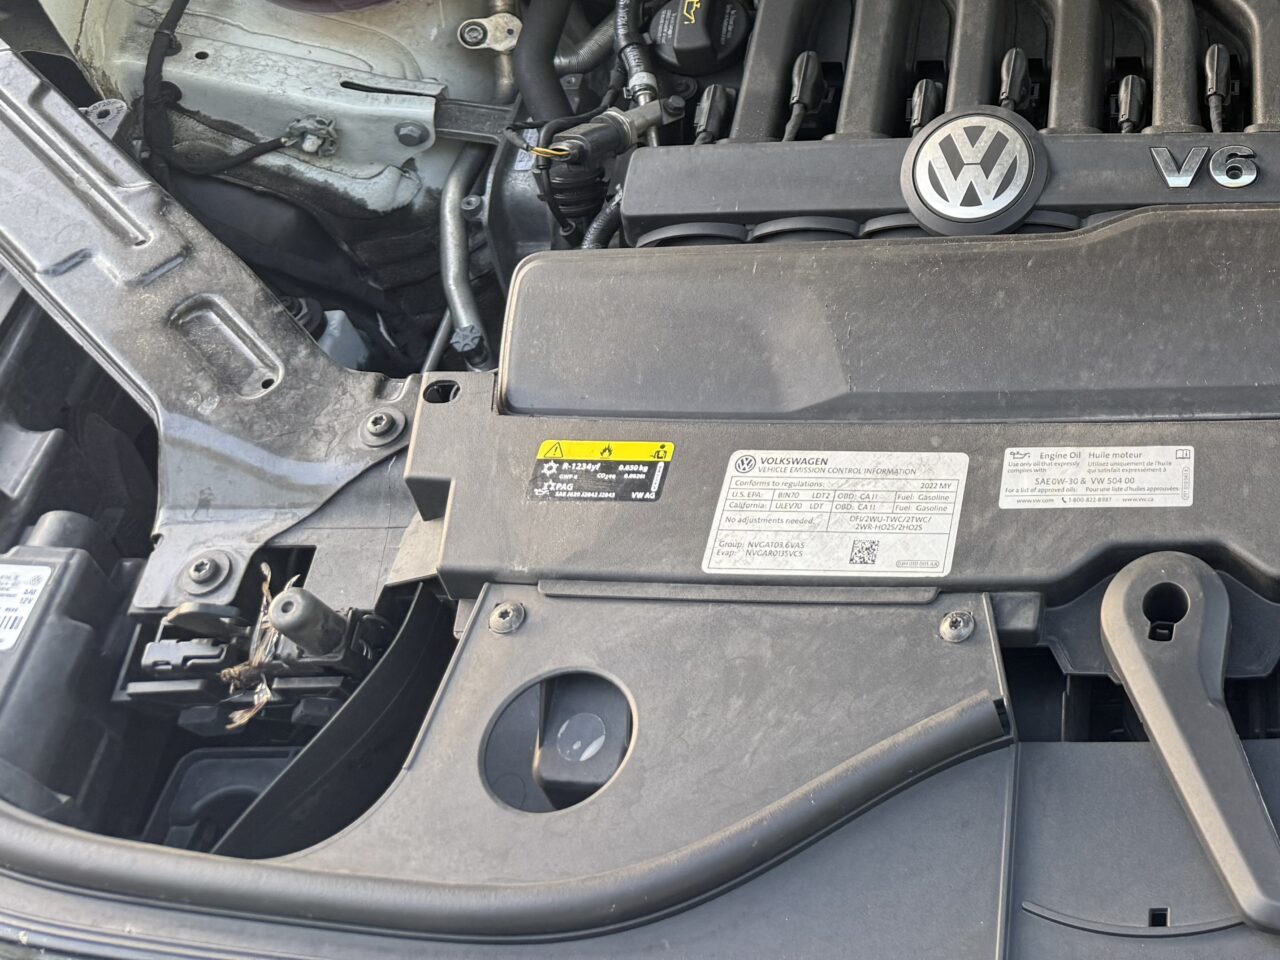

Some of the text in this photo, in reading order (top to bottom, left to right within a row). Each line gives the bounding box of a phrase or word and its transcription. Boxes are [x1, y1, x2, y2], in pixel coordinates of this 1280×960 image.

[1150, 146, 1258, 189] V6
[1040, 452, 1067, 460] Engine
[761, 457, 828, 465] VOLKSWAGEN
[562, 463, 601, 471] R-1234yf
[738, 516, 784, 525] adjustments
